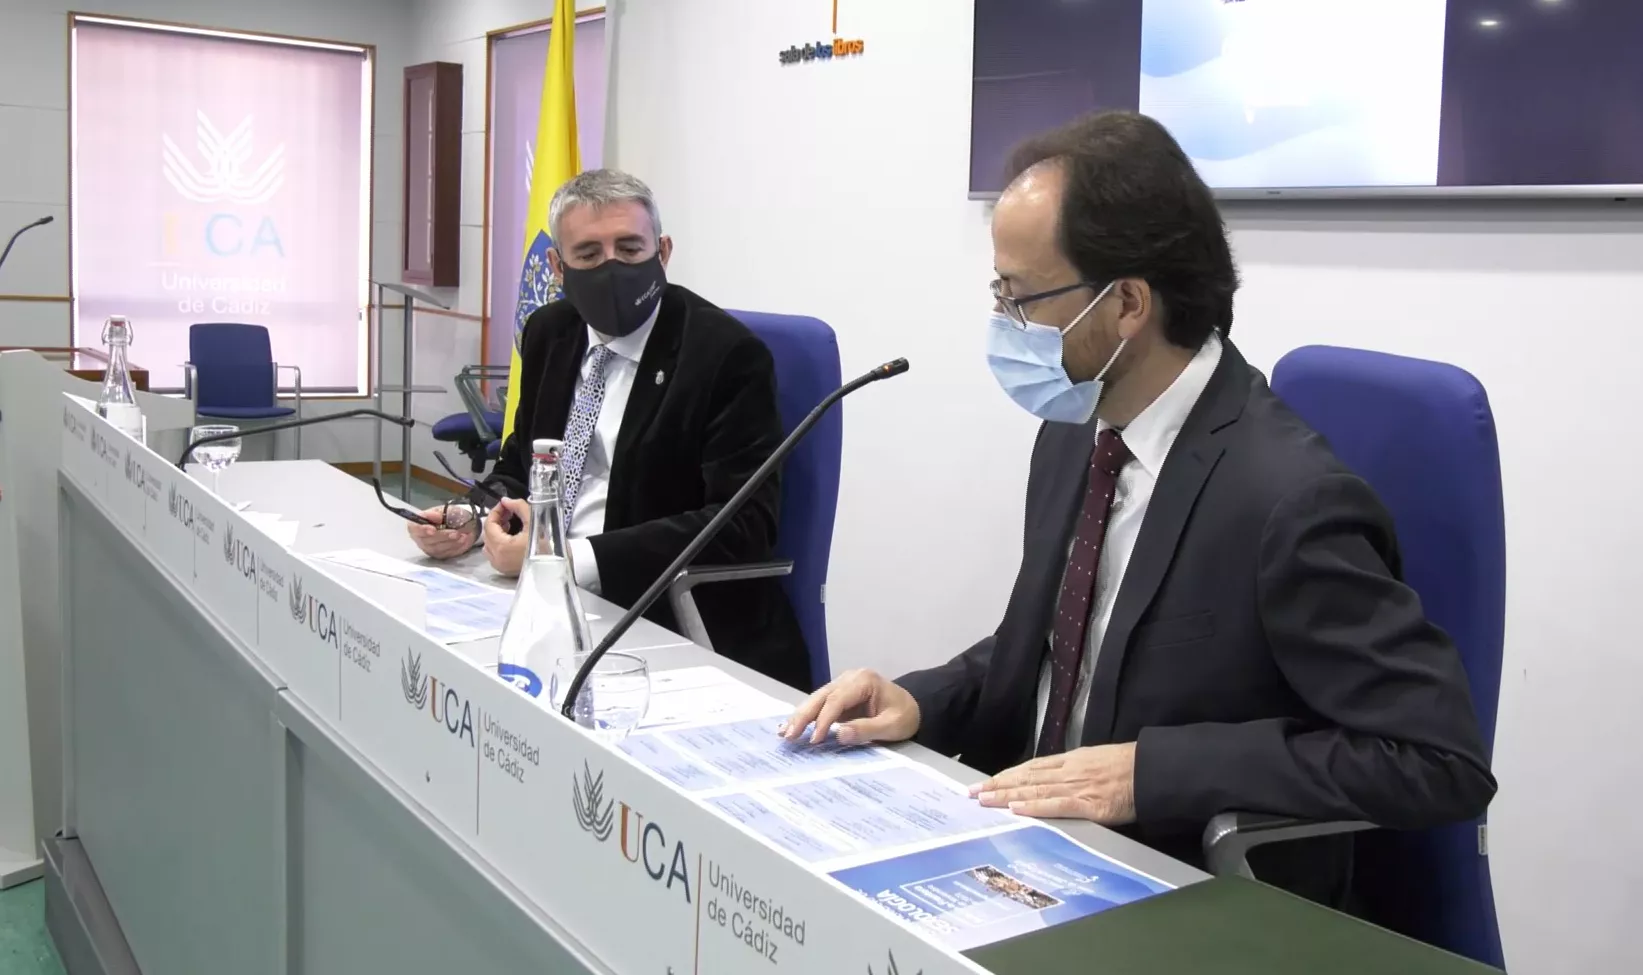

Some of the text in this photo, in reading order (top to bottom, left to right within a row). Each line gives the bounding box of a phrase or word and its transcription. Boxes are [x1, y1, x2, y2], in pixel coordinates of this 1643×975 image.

[178, 297, 204, 313] de
[236, 539, 257, 585] UCA
[308, 594, 338, 650] UCA
[343, 618, 381, 657] Universidad
[430, 675, 475, 748] UCA
[484, 712, 540, 766] Universidad
[484, 741, 525, 783] de Cádiz
[619, 800, 692, 904] UCA
[708, 860, 806, 947] Universidad
[707, 898, 778, 965] de Cádiz
